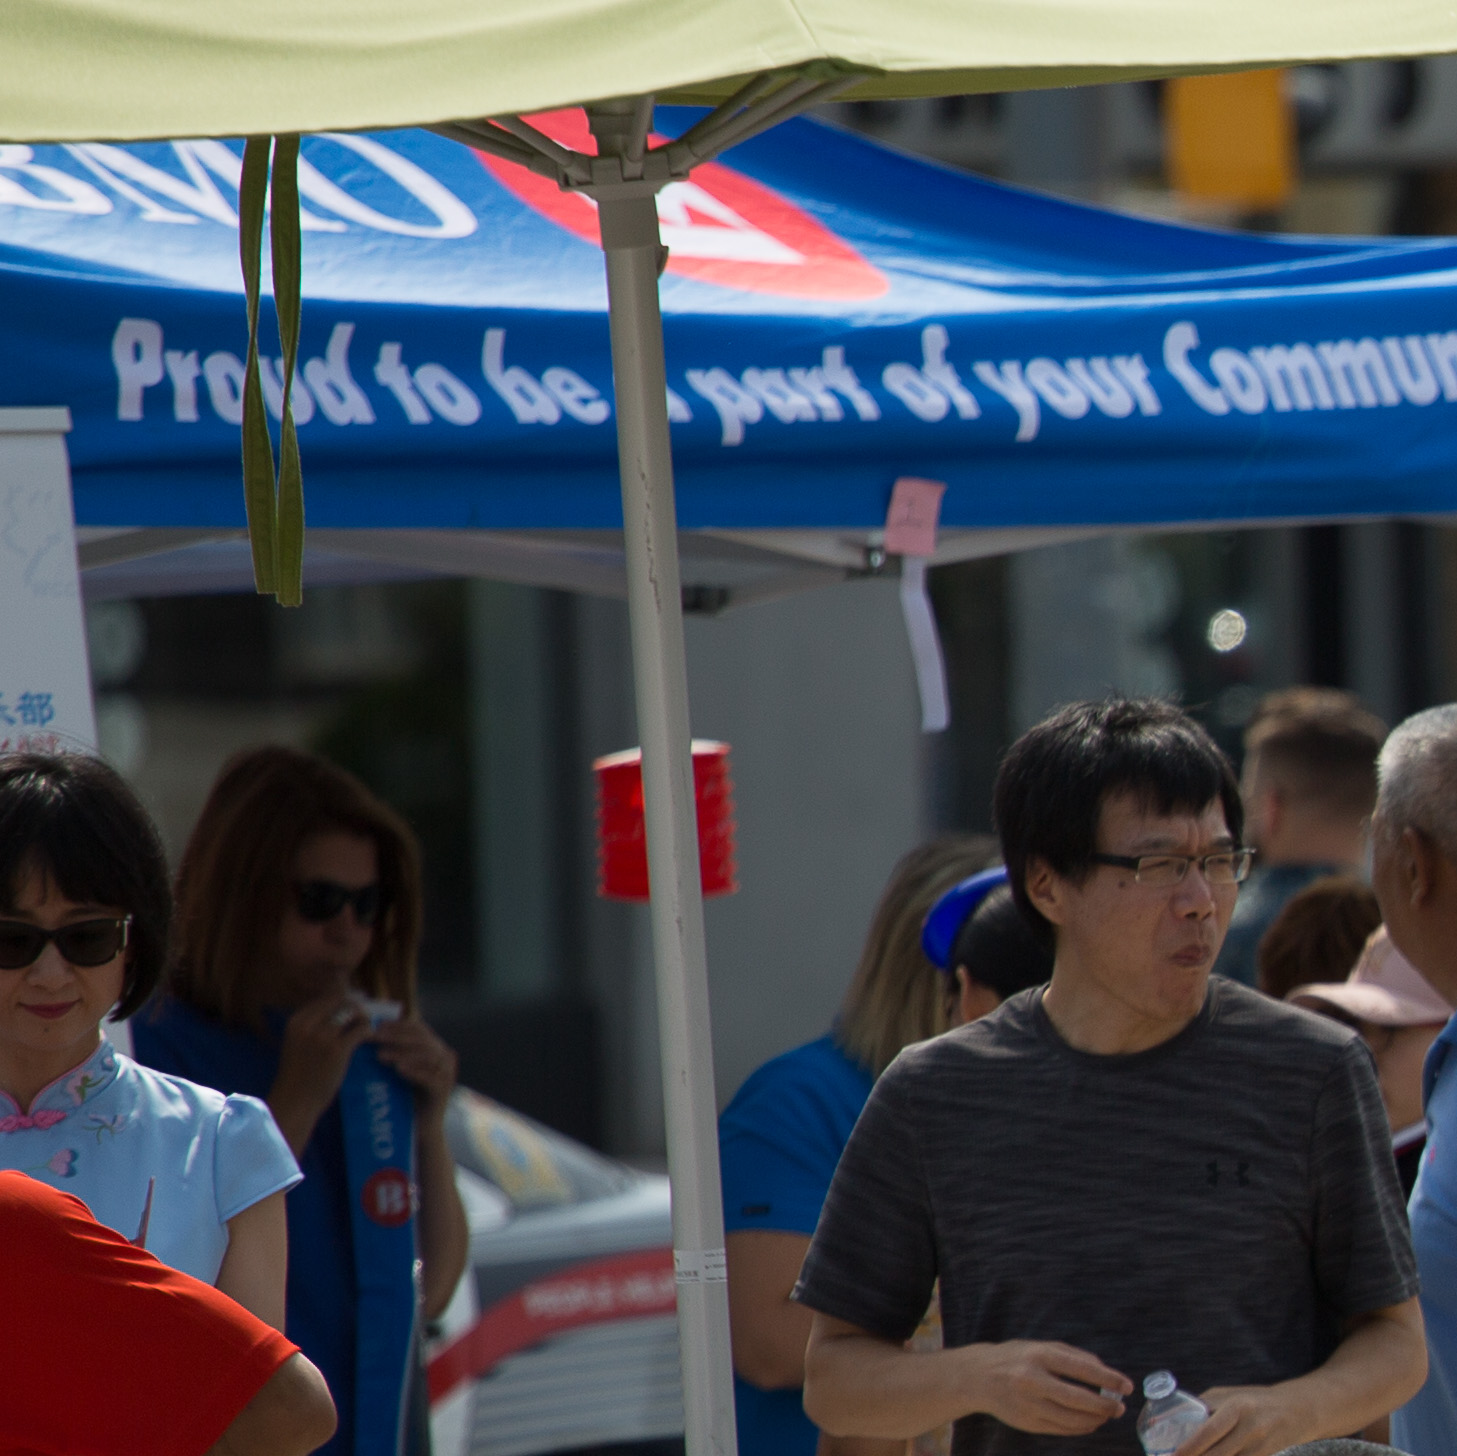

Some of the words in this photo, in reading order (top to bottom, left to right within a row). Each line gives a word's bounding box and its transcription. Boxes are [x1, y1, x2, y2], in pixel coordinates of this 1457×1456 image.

[112, 318, 376, 424] Proud
[374, 341, 483, 425] to
[482, 328, 610, 426] be
[686, 346, 881, 447] part
[882, 323, 981, 423] of
[973, 352, 1163, 443] your
